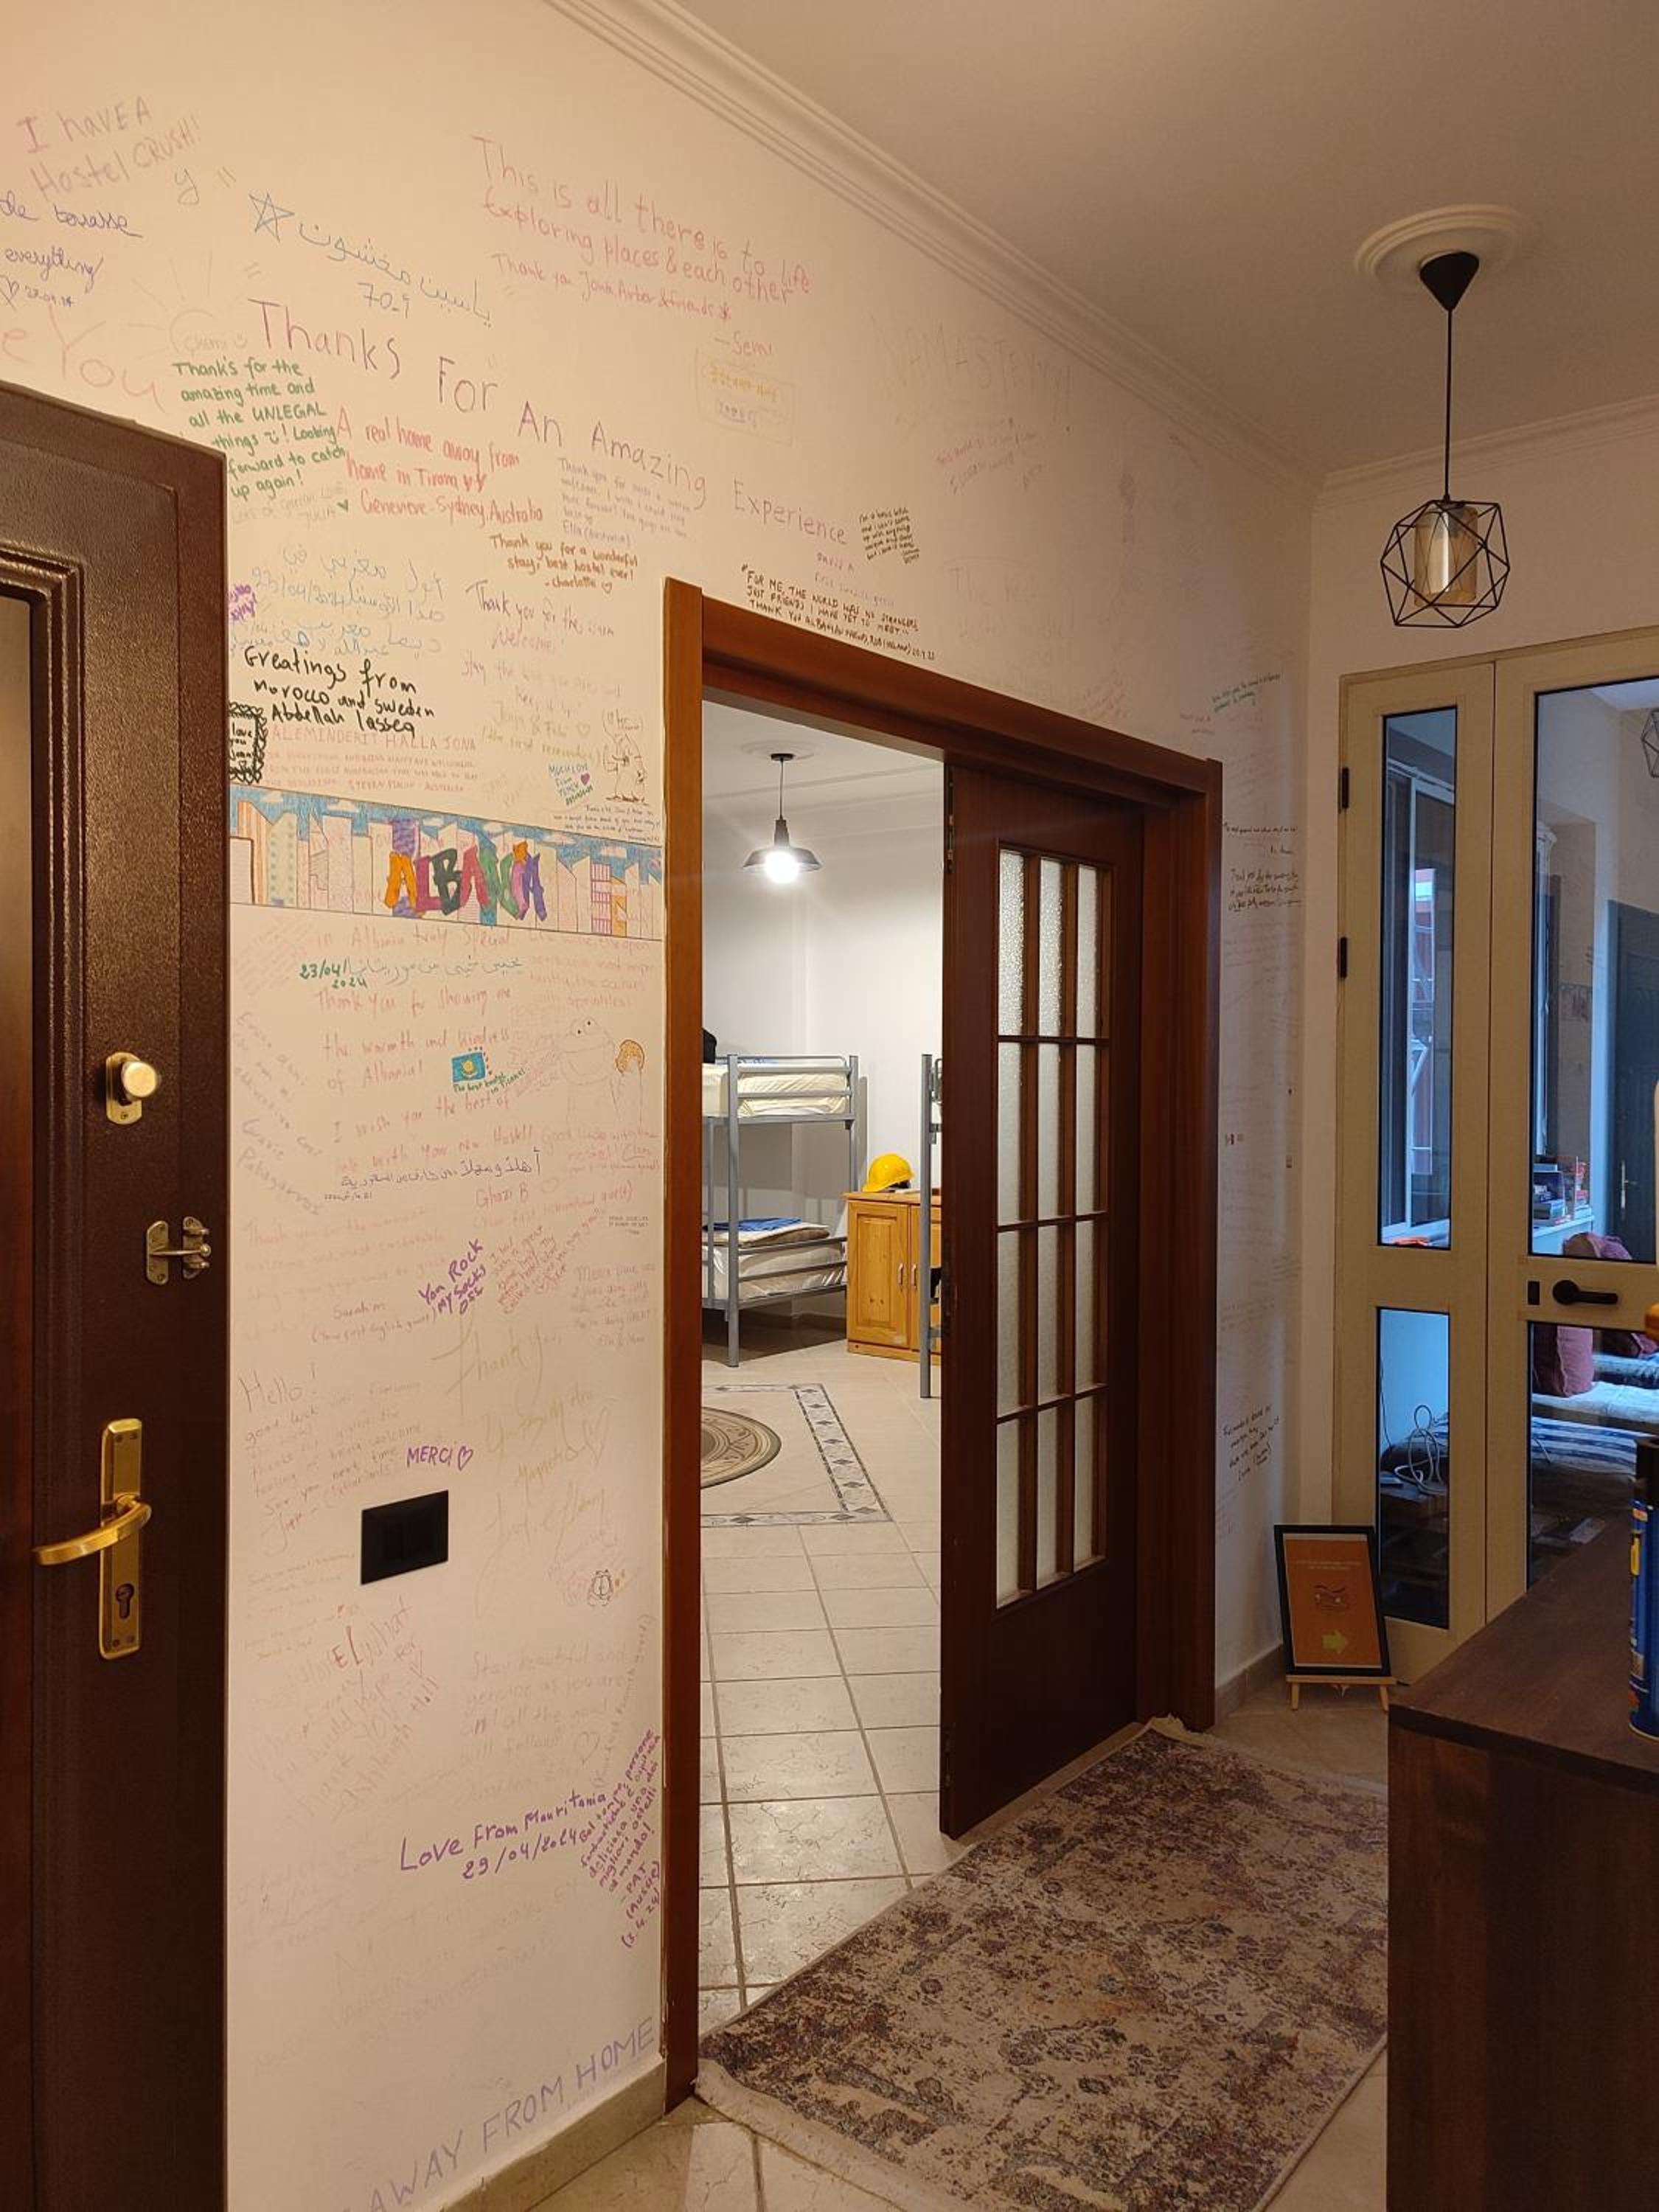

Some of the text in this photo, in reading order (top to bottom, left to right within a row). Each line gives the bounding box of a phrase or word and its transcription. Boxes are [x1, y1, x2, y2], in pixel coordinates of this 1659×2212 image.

[470, 134, 539, 195] This
[587, 178, 622, 223] all
[636, 192, 706, 252] there
[741, 239, 765, 277] to
[683, 260, 726, 287] each
[732, 268, 798, 305] other
[245, 356, 268, 379] for
[272, 358, 304, 377] the
[246, 382, 281, 398] time
[287, 377, 316, 394] and
[189, 402, 327, 428] all the UNLEGAL
[248, 297, 849, 545] Thanks For An Amazing Experience
[212, 425, 336, 457] things Looking
[289, 451, 306, 466] to
[310, 445, 347, 464] catch
[365, 417, 390, 443] real
[397, 417, 433, 453] home
[442, 439, 481, 473] away
[489, 444, 521, 473] from
[346, 450, 388, 482] home
[397, 465, 412, 487] in
[230, 485, 251, 502] up
[489, 532, 639, 568] Thank you for a wonderful
[544, 555, 569, 572] best
[574, 561, 605, 575] hostel
[465, 580, 512, 616] Thank
[787, 586, 807, 599] THE
[749, 599, 782, 616] THANK
[358, 658, 417, 699] from
[338, 689, 366, 709] and
[271, 702, 346, 726] Abdellah
[384, 839, 548, 922] ALBANIA
[331, 977, 368, 990] 2024
[448, 1237, 484, 1283] ROCK
[437, 1292, 454, 1315] MY
[406, 1445, 453, 1469] MERCI
[400, 1836, 465, 1872] Love
[524, 1788, 608, 1832] Mauritania
[369, 2016, 655, 2212] AWAY FROM HOME
